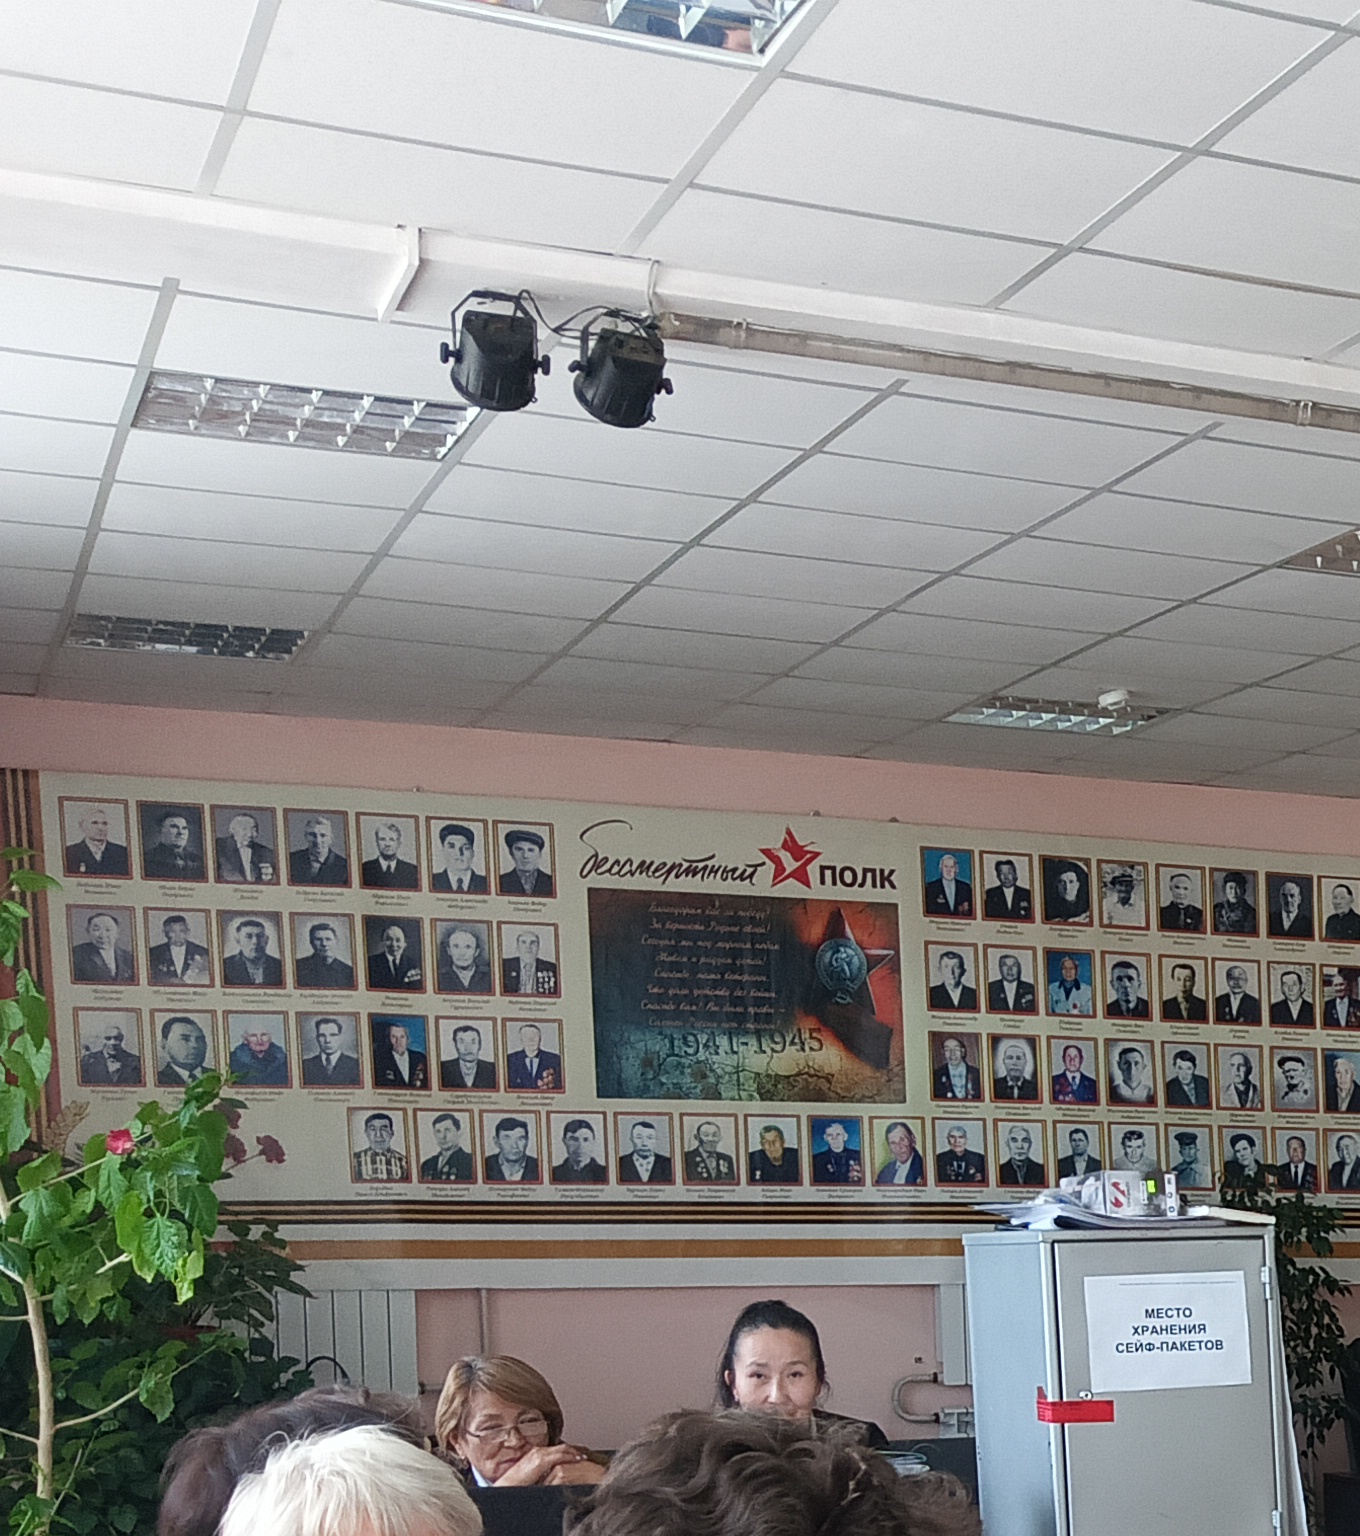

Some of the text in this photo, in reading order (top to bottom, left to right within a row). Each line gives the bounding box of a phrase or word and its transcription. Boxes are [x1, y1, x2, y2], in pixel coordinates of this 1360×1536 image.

[818, 864, 897, 890] ПОЛК
[664, 1028, 824, 1056] 1941-1945
[1145, 1307, 1193, 1319] МЕСТО
[1131, 1323, 1207, 1336] ХРАНЕНИЯ
[1115, 1339, 1224, 1353] СЕЙФ-ПАКЕТОВ
